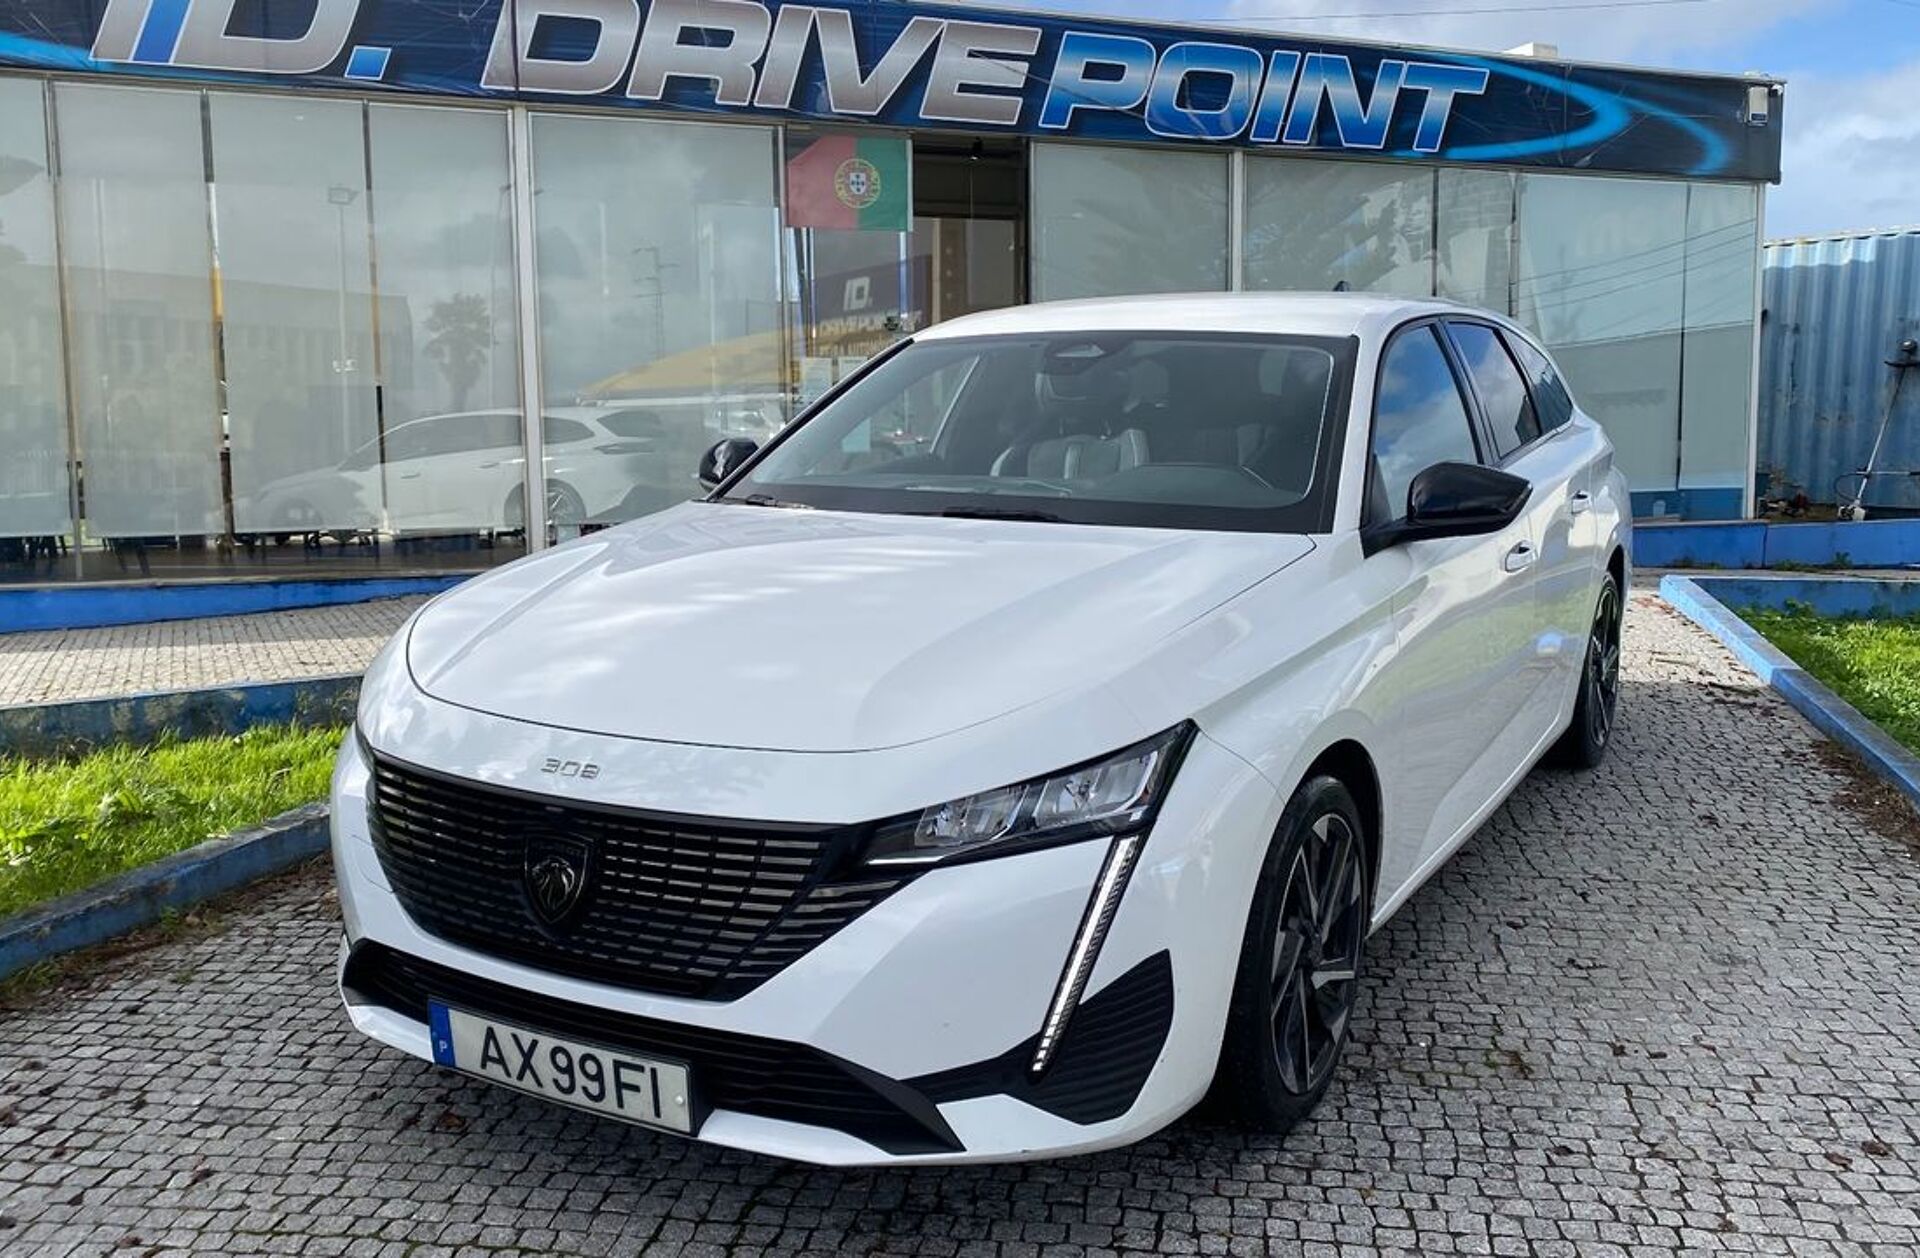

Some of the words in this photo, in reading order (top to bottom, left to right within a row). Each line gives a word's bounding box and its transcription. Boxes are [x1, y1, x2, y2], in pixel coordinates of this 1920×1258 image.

[89, 0, 392, 80] ID.
[540, 757, 601, 780] 308
[480, 1026, 662, 1119] AX99FI
